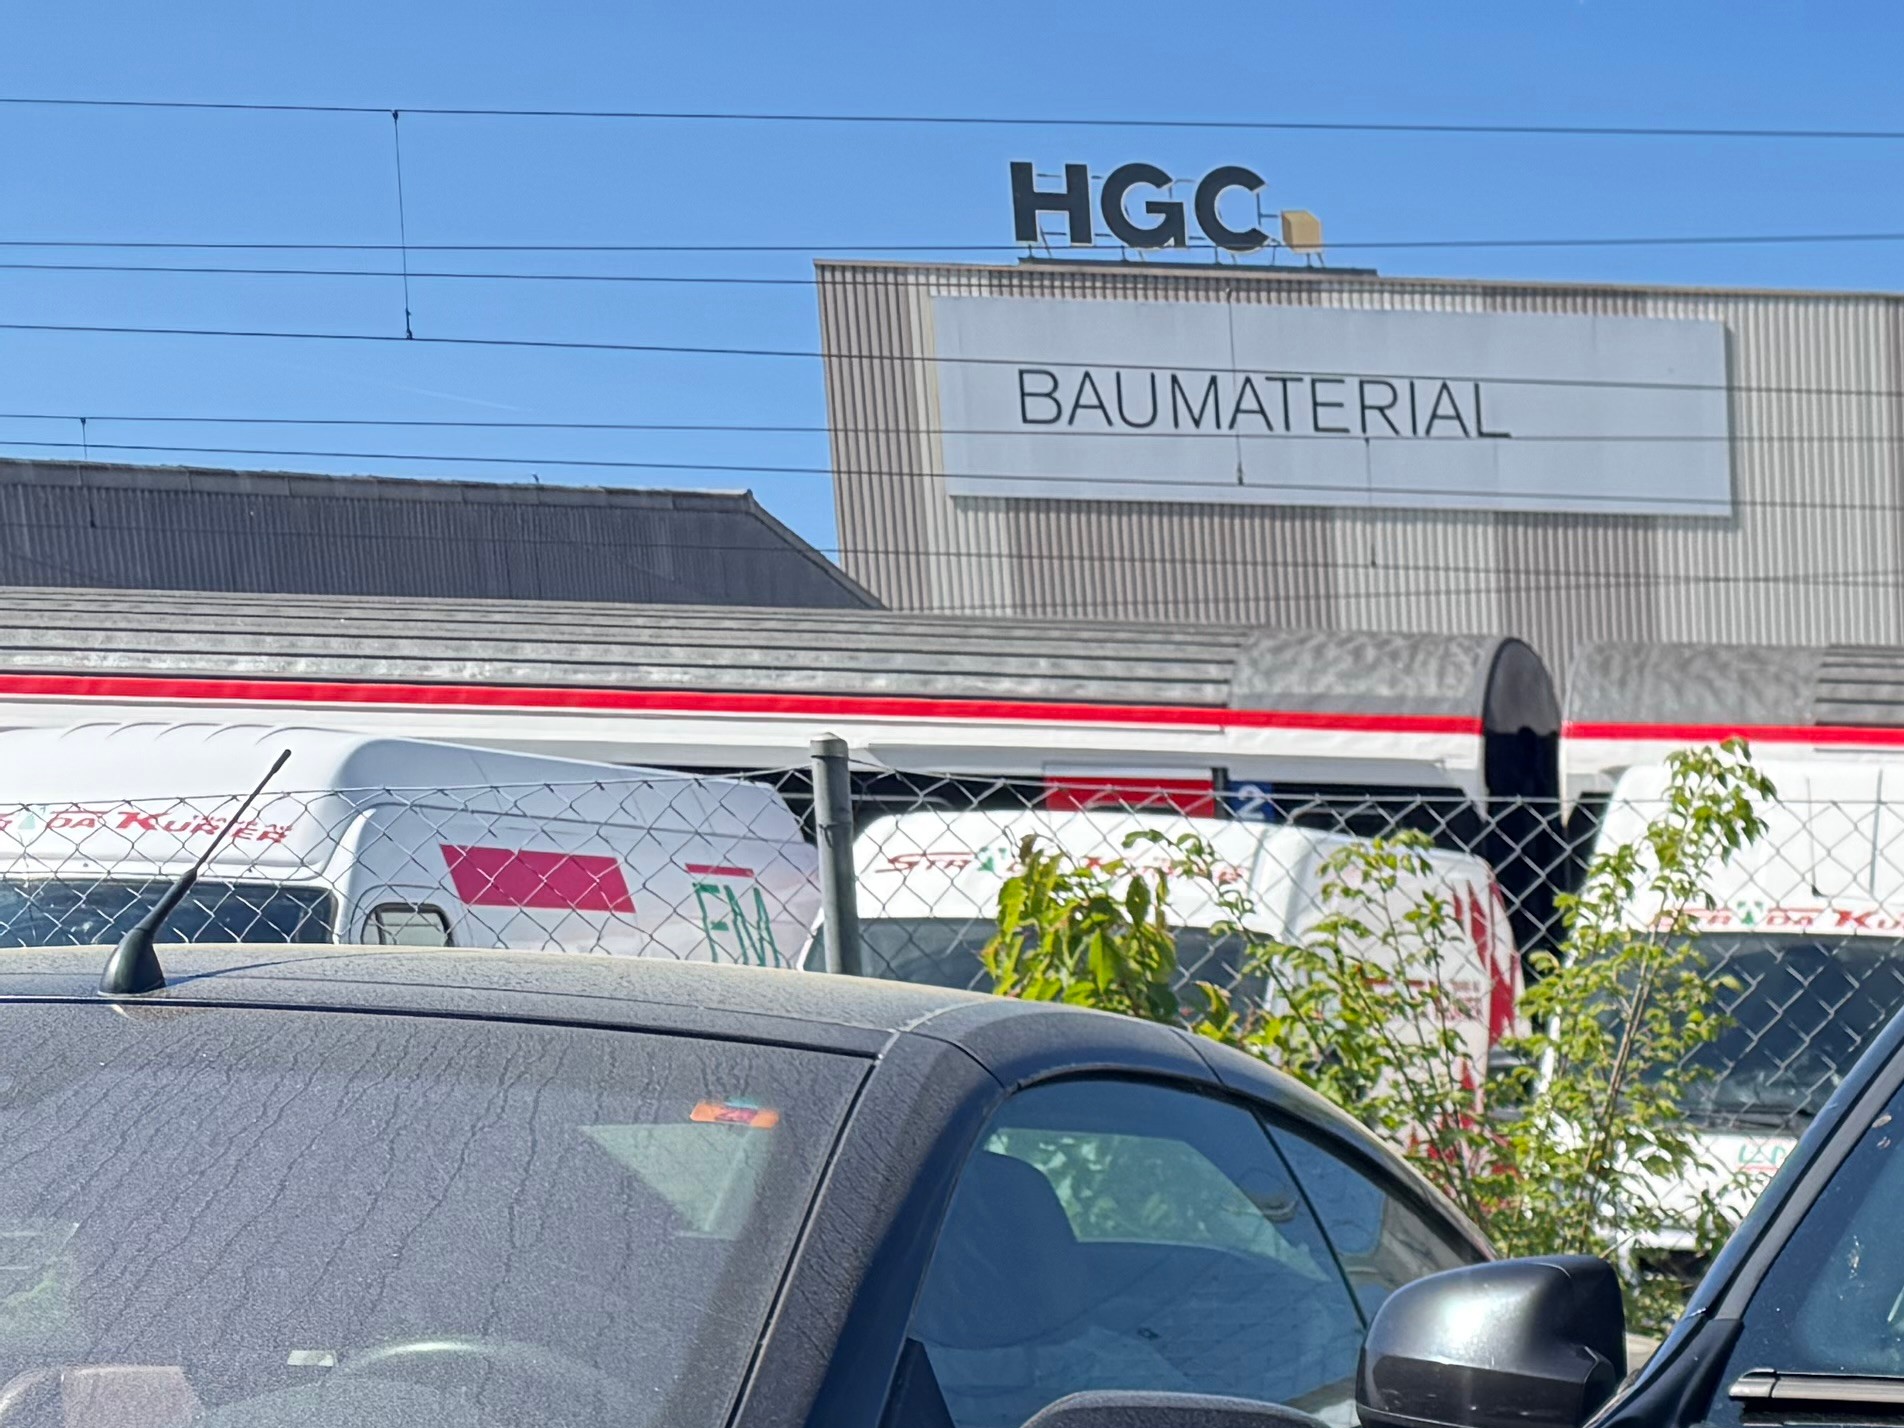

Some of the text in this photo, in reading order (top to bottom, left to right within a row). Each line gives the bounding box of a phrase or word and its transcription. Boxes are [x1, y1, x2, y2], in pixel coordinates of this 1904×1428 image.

[1010, 161, 1269, 251] HGC
[1018, 368, 1512, 439] BAUMATERIAL
[116, 810, 287, 844] KURER
[1237, 783, 1266, 820] 2
